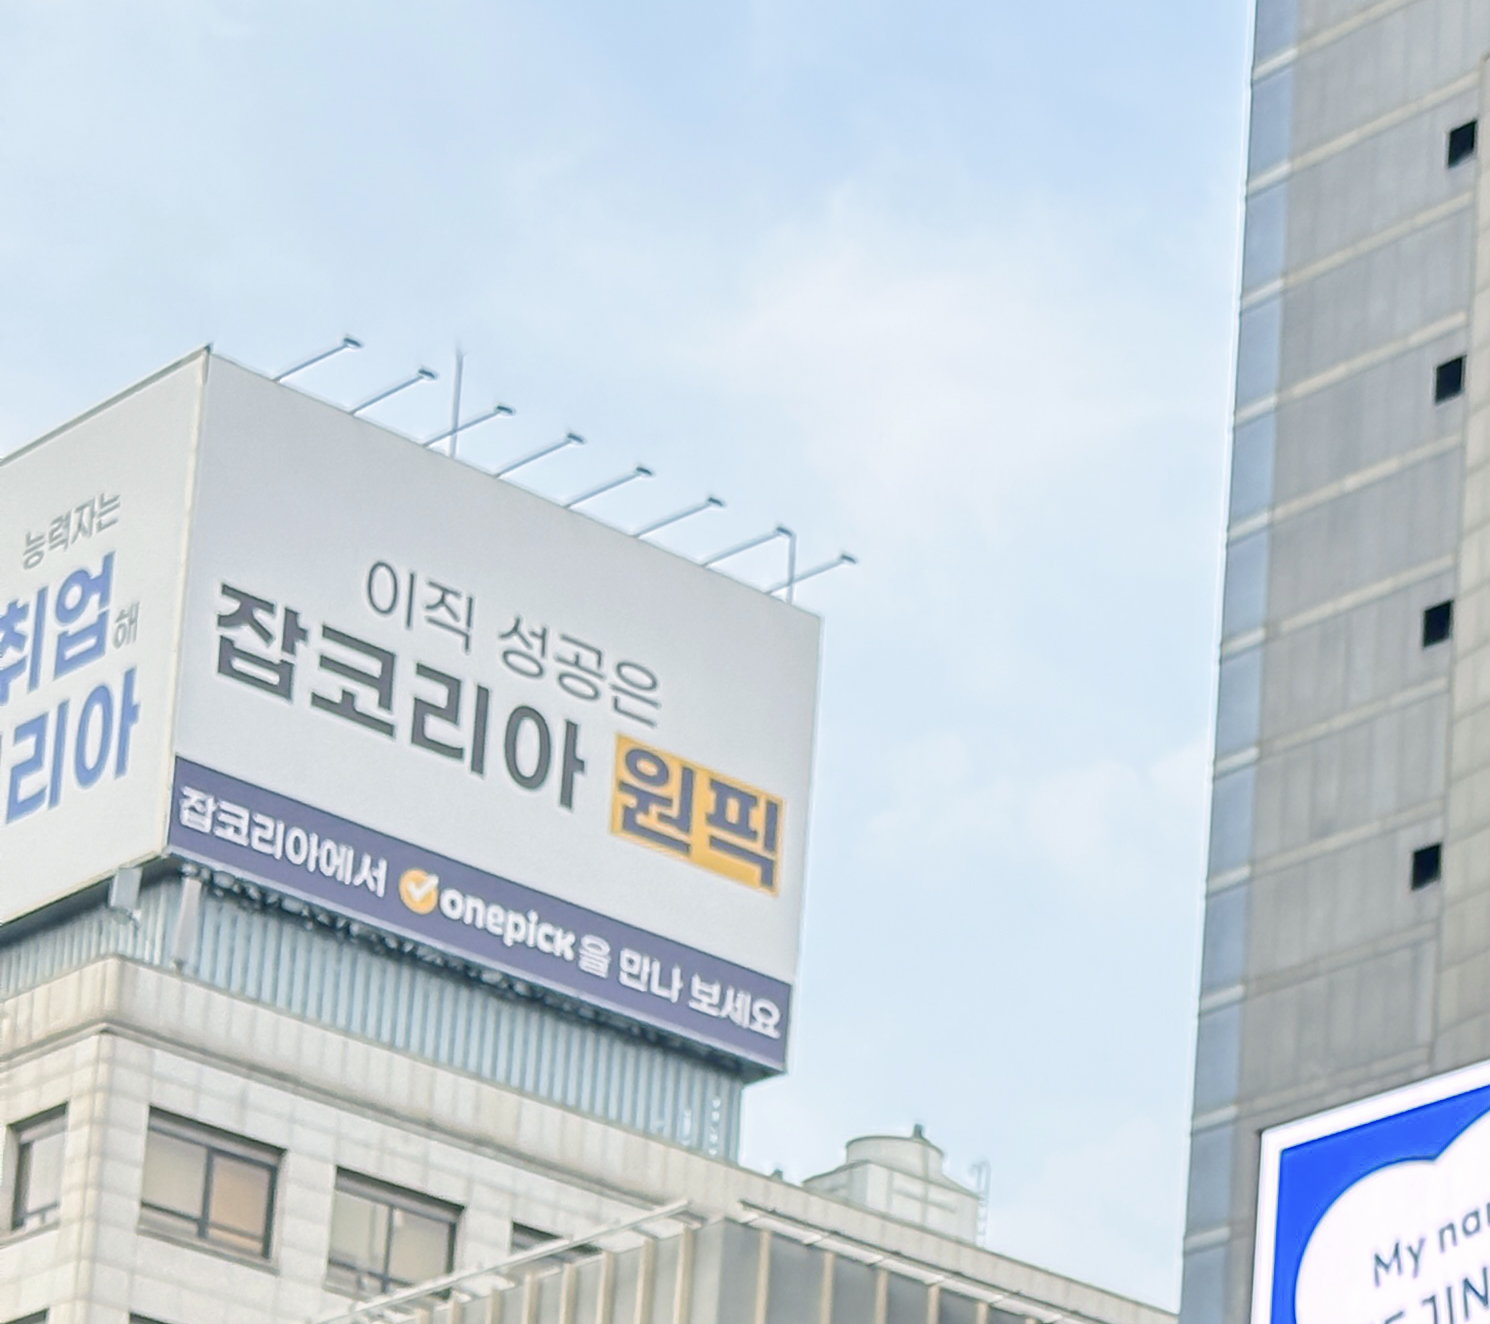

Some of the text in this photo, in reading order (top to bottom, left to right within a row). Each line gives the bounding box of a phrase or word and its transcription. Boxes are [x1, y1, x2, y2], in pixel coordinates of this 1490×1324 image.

[23, 494, 120, 570] 능력자는
[367, 561, 661, 727] 이직 성공은
[0, 664, 141, 825] 리아
[216, 582, 779, 891] 잡코리아 원픽
[179, 786, 389, 898] 잡코리아에서
[618, 947, 684, 1003] 만나
[688, 973, 782, 1040] 보세요
[1373, 1242, 1426, 1288] My
